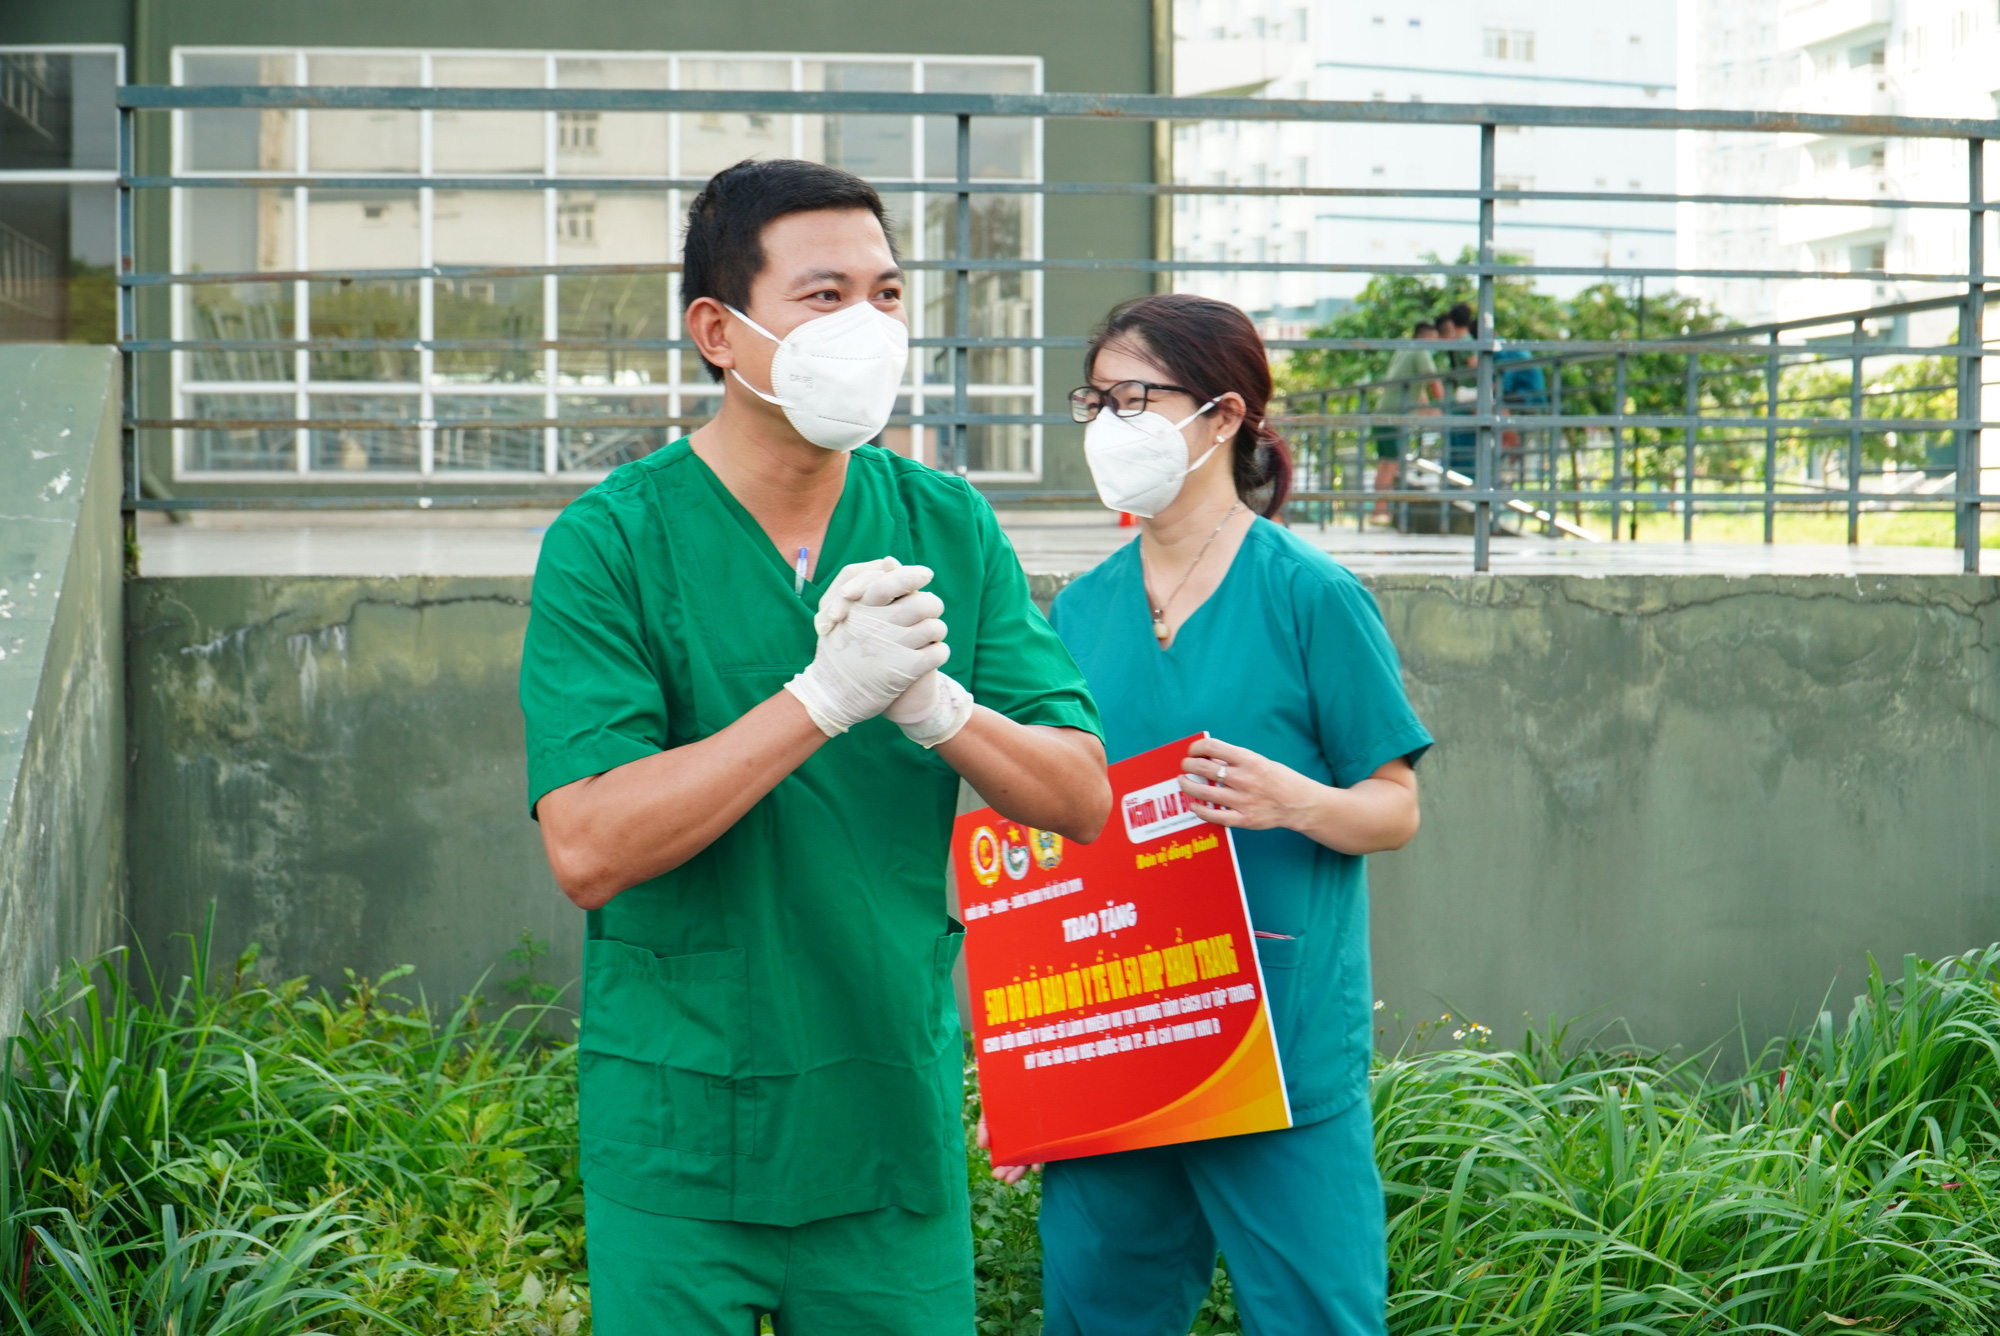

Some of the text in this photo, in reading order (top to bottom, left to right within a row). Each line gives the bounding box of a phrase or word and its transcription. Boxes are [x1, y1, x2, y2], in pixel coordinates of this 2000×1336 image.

[1062, 899, 1138, 942] TRAO TẶNG
[984, 987, 1008, 1026] 500
[1005, 976, 1026, 1028] BỘ
[1039, 965, 1067, 1015] BẢO
[1063, 962, 1085, 1015] HỘ
[1080, 967, 1094, 1005] Y
[1090, 949, 1112, 1003] TẾ
[1105, 952, 1129, 1000] VÀ
[1122, 956, 1142, 997] 50
[1138, 944, 1165, 999] HỘP
[1161, 927, 1198, 988] KHẨU
[1193, 933, 1240, 980] TRANG
[983, 1036, 1001, 1054] CHO
[1039, 1023, 1058, 1043] BÁC
[1134, 1003, 1163, 1023] TRUNG
[1179, 993, 1204, 1014] CÁCH
[1200, 992, 1213, 1010] LY
[1210, 986, 1229, 1010] TẬP
[1226, 982, 1257, 1004] TRUNG
[1077, 1042, 1097, 1062] HỌC
[1095, 1033, 1119, 1057] QUỐC
[1117, 1035, 1134, 1052] GIA
[1143, 1024, 1159, 1047] HỒ
[1157, 1023, 1174, 1045] CHÍ
[1171, 1022, 1197, 1042] MINH
[1193, 1019, 1214, 1038] KHU
[1211, 1017, 1222, 1034] B
